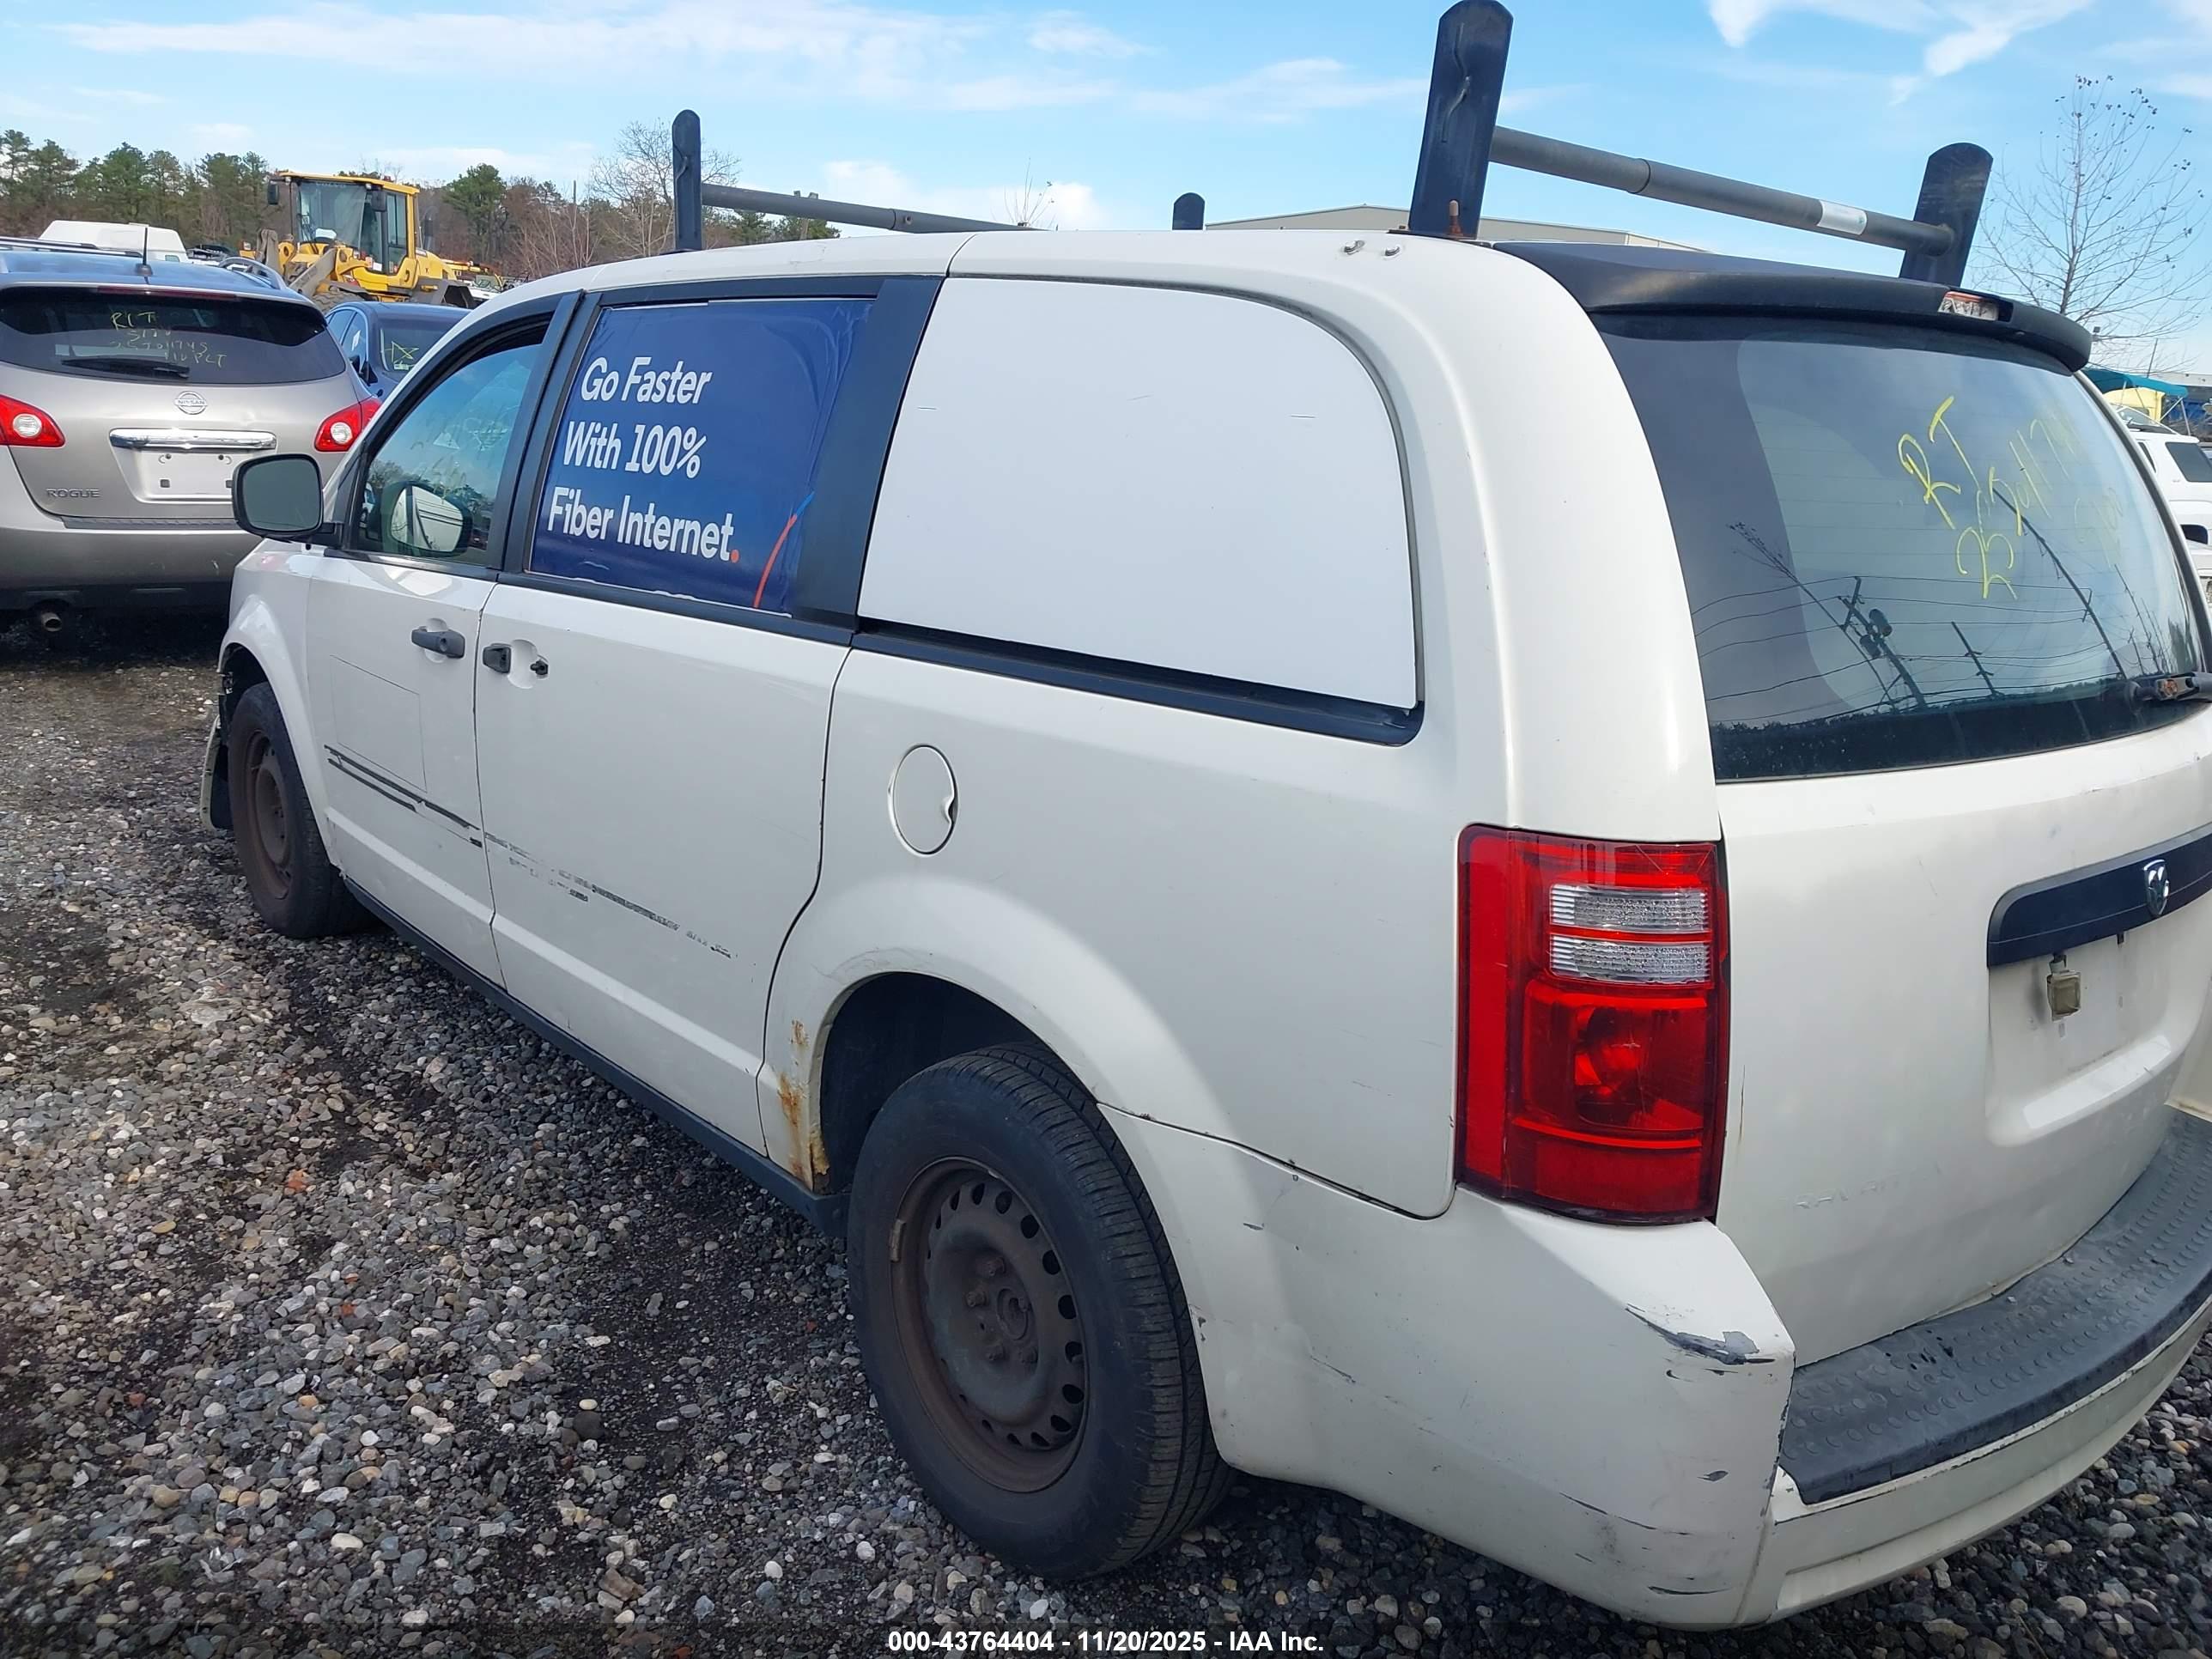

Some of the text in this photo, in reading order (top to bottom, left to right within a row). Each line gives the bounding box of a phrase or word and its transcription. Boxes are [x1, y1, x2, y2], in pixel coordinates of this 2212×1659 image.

[580, 356, 713, 404] Go Faster
[562, 420, 708, 479] With 100%
[46, 488, 101, 499] ROGUE
[547, 486, 740, 563] Fiber Internet.
